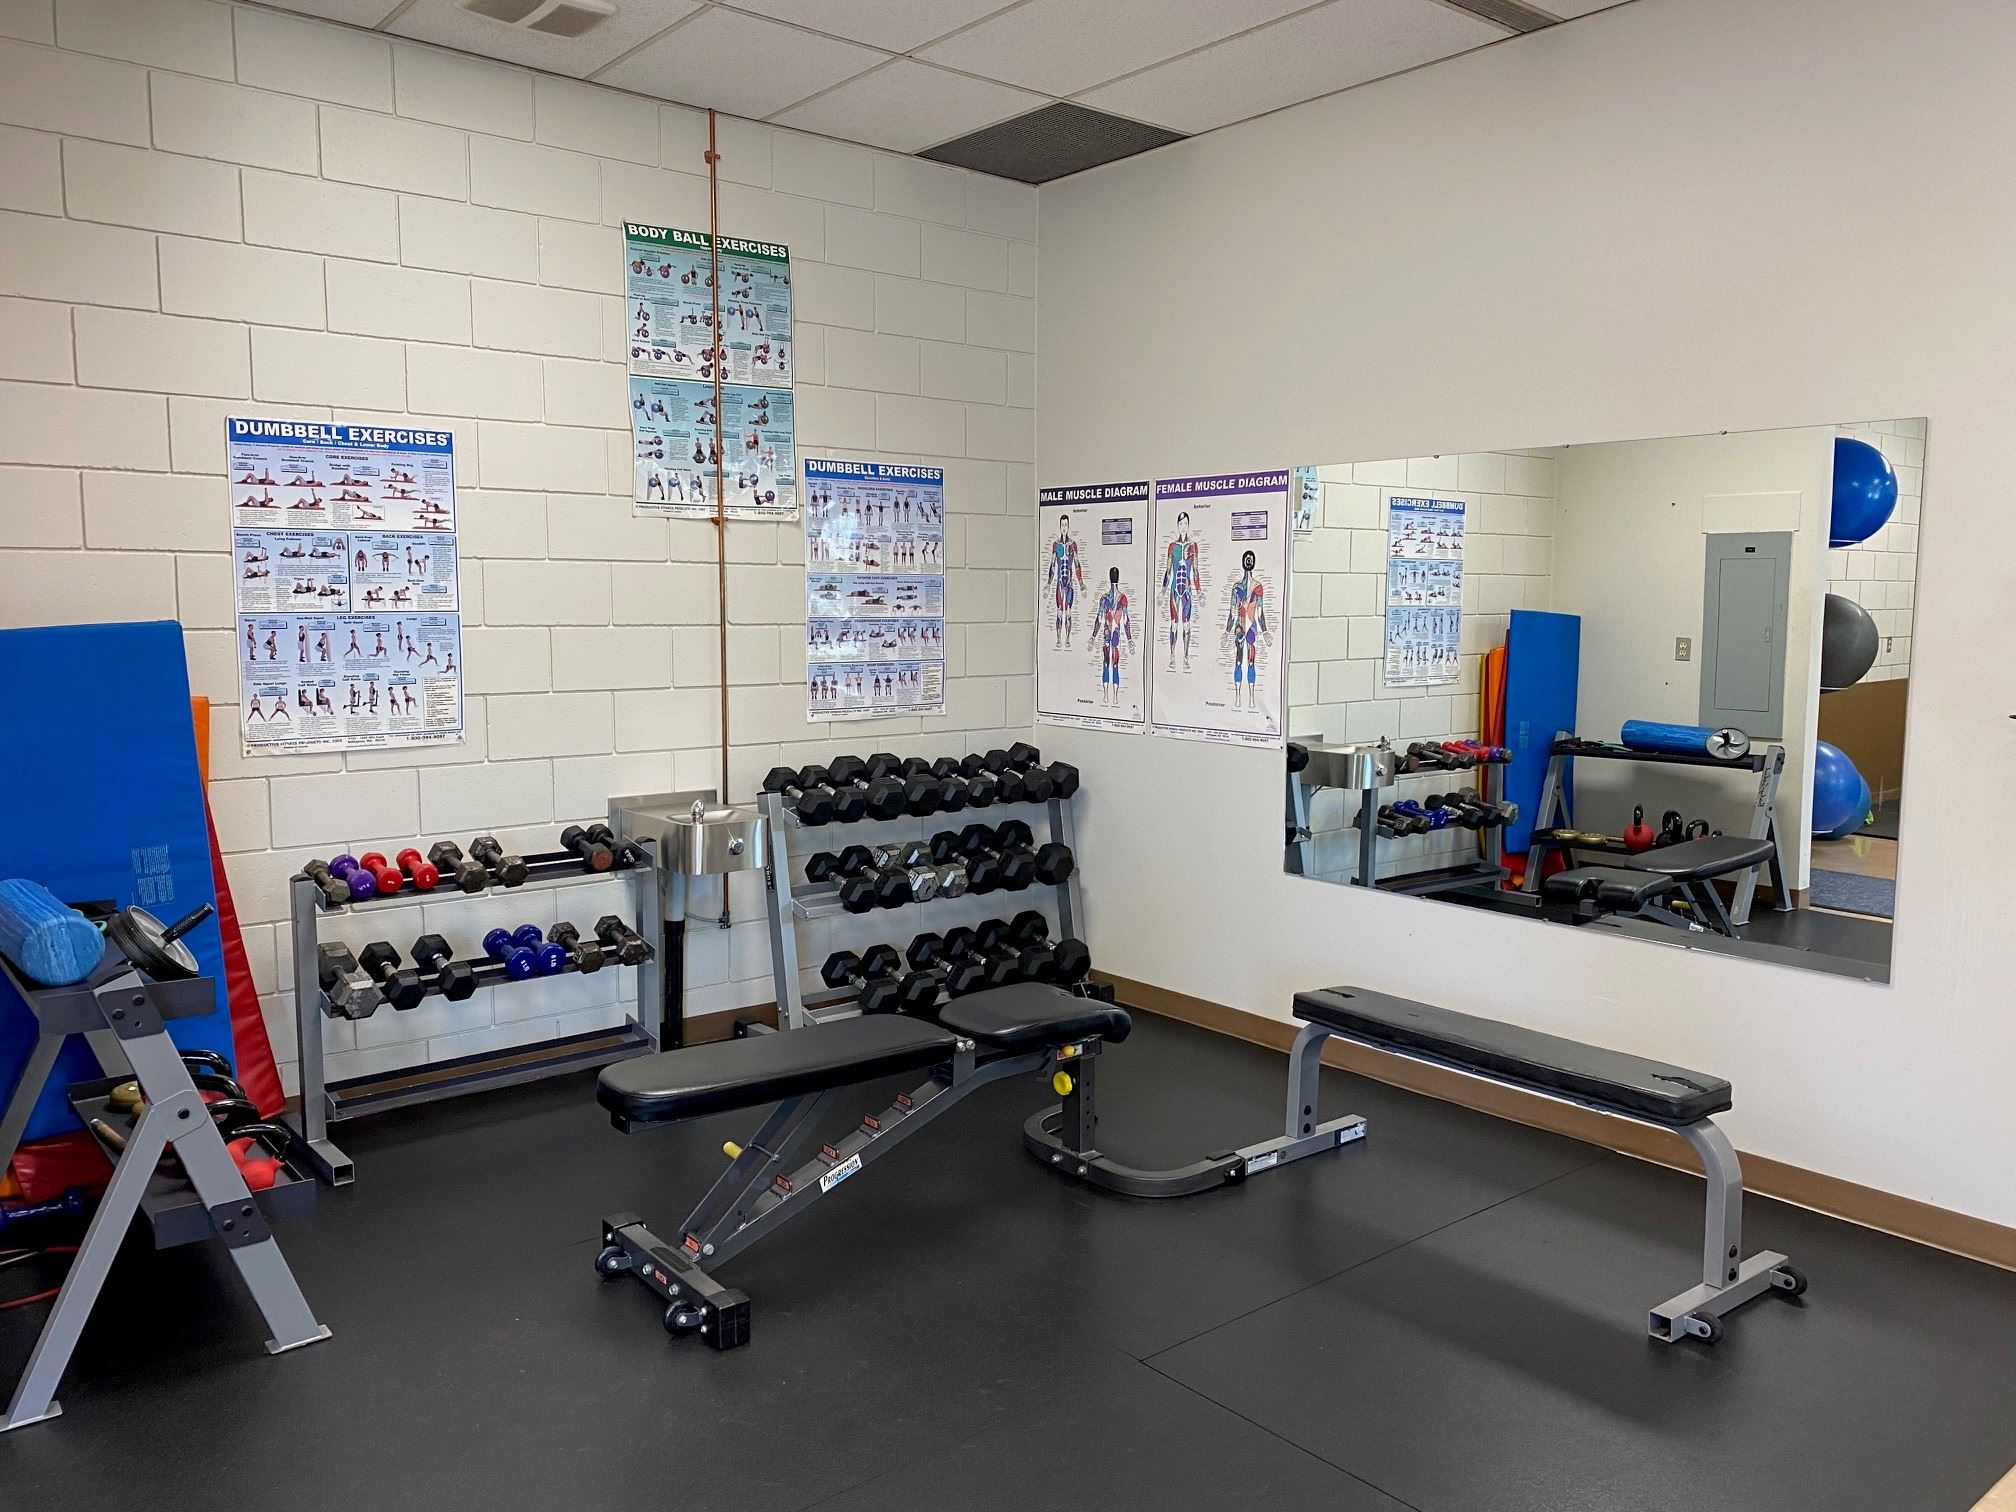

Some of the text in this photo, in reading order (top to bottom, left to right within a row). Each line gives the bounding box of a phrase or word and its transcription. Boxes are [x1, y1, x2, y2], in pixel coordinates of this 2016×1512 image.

[628, 224, 787, 258] BODY BALL EXERCISES
[235, 420, 448, 446] DUMBBELL EXERCISES
[809, 460, 940, 480] DUMBBELL EXERCISES
[1040, 485, 1148, 502] MALE MUSCLE DIAGRAM
[1156, 475, 1288, 494] FEMALE MUSCLE DIAGRAM
[823, 1158, 859, 1187] PROGRESSION
